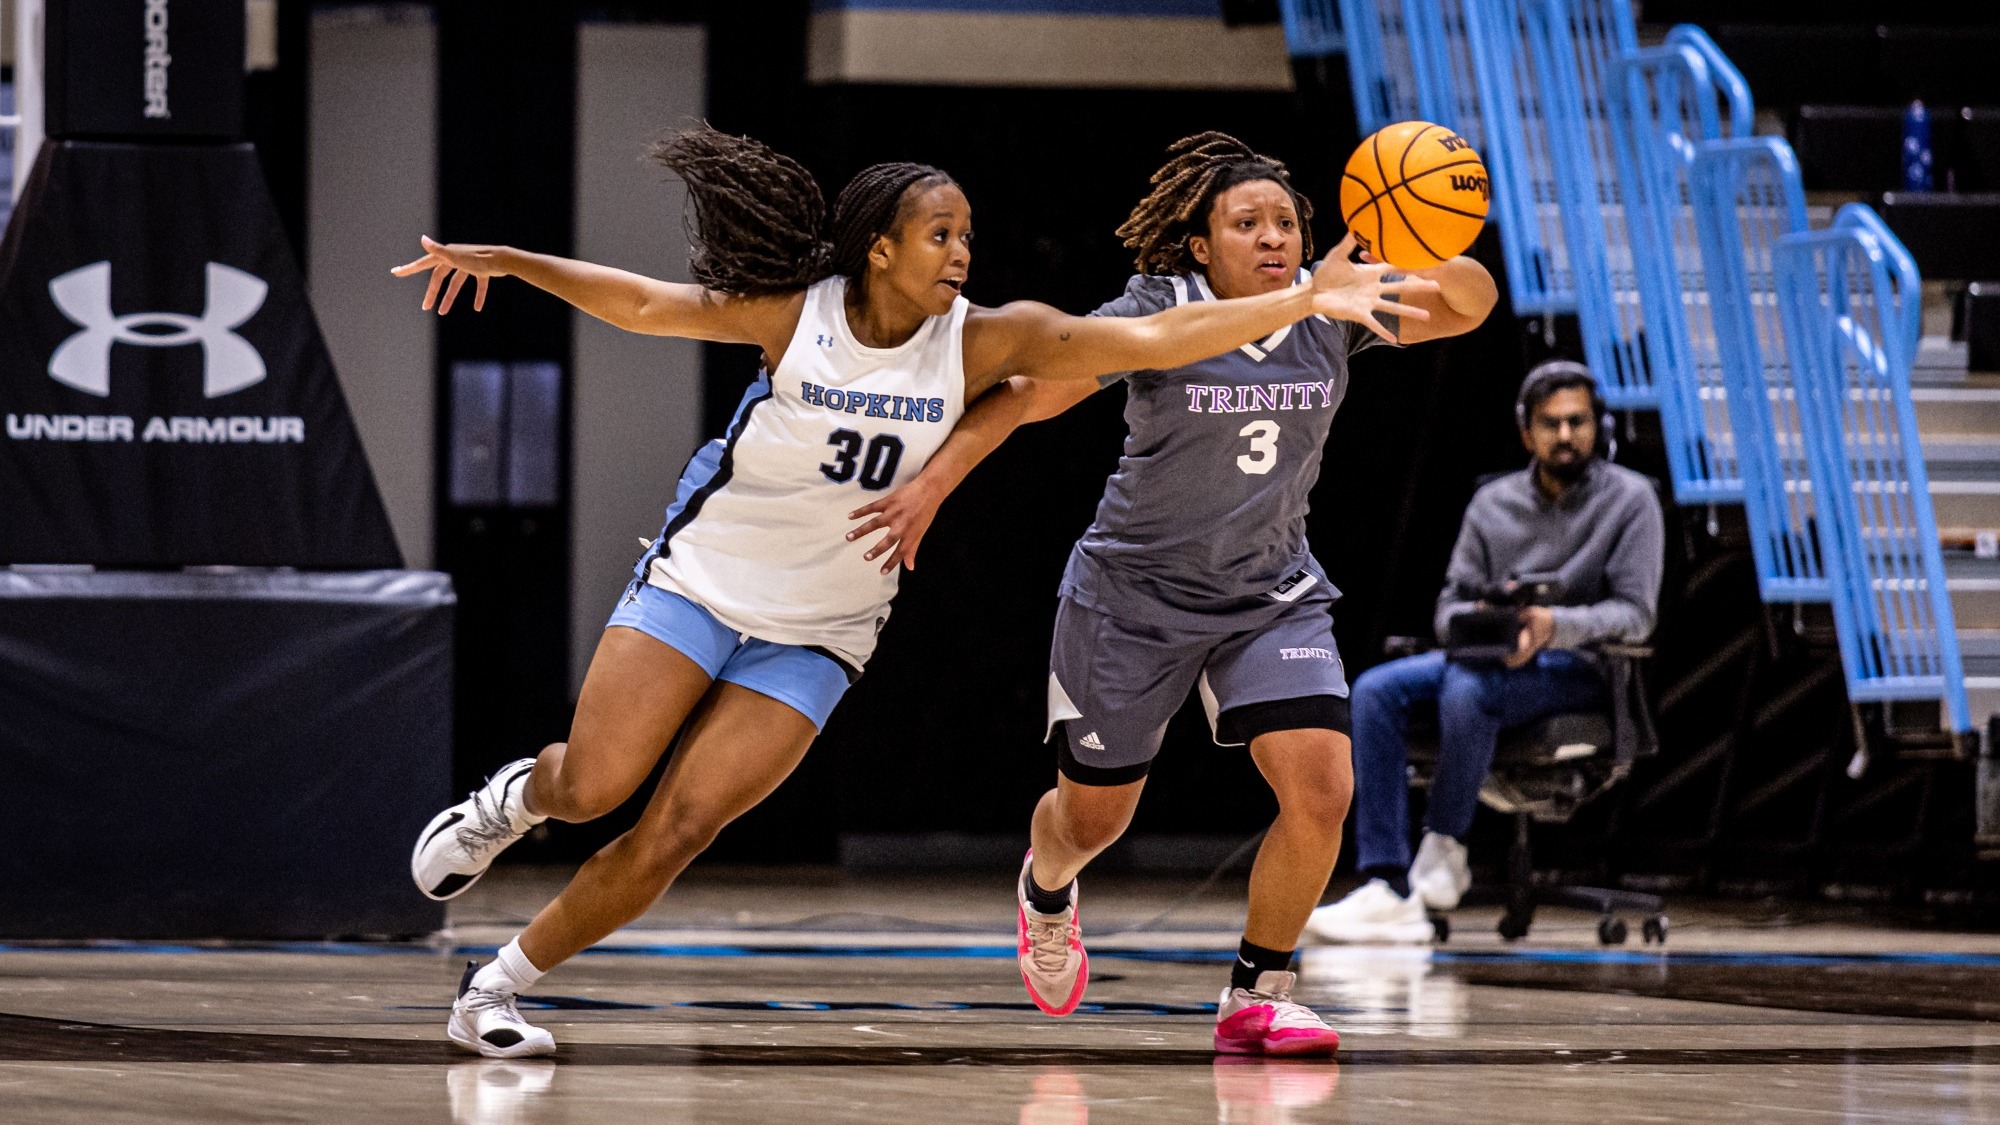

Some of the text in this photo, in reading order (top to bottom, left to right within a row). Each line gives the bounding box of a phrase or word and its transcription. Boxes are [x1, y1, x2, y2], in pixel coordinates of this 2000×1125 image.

[801, 381, 944, 422] HOPKINS
[1186, 379, 1334, 413] TRINITY
[6, 413, 305, 443] UNDER ARMOUR
[819, 427, 906, 491] 30
[1237, 420, 1281, 474] 3
[1280, 647, 1332, 660] TRINITY
